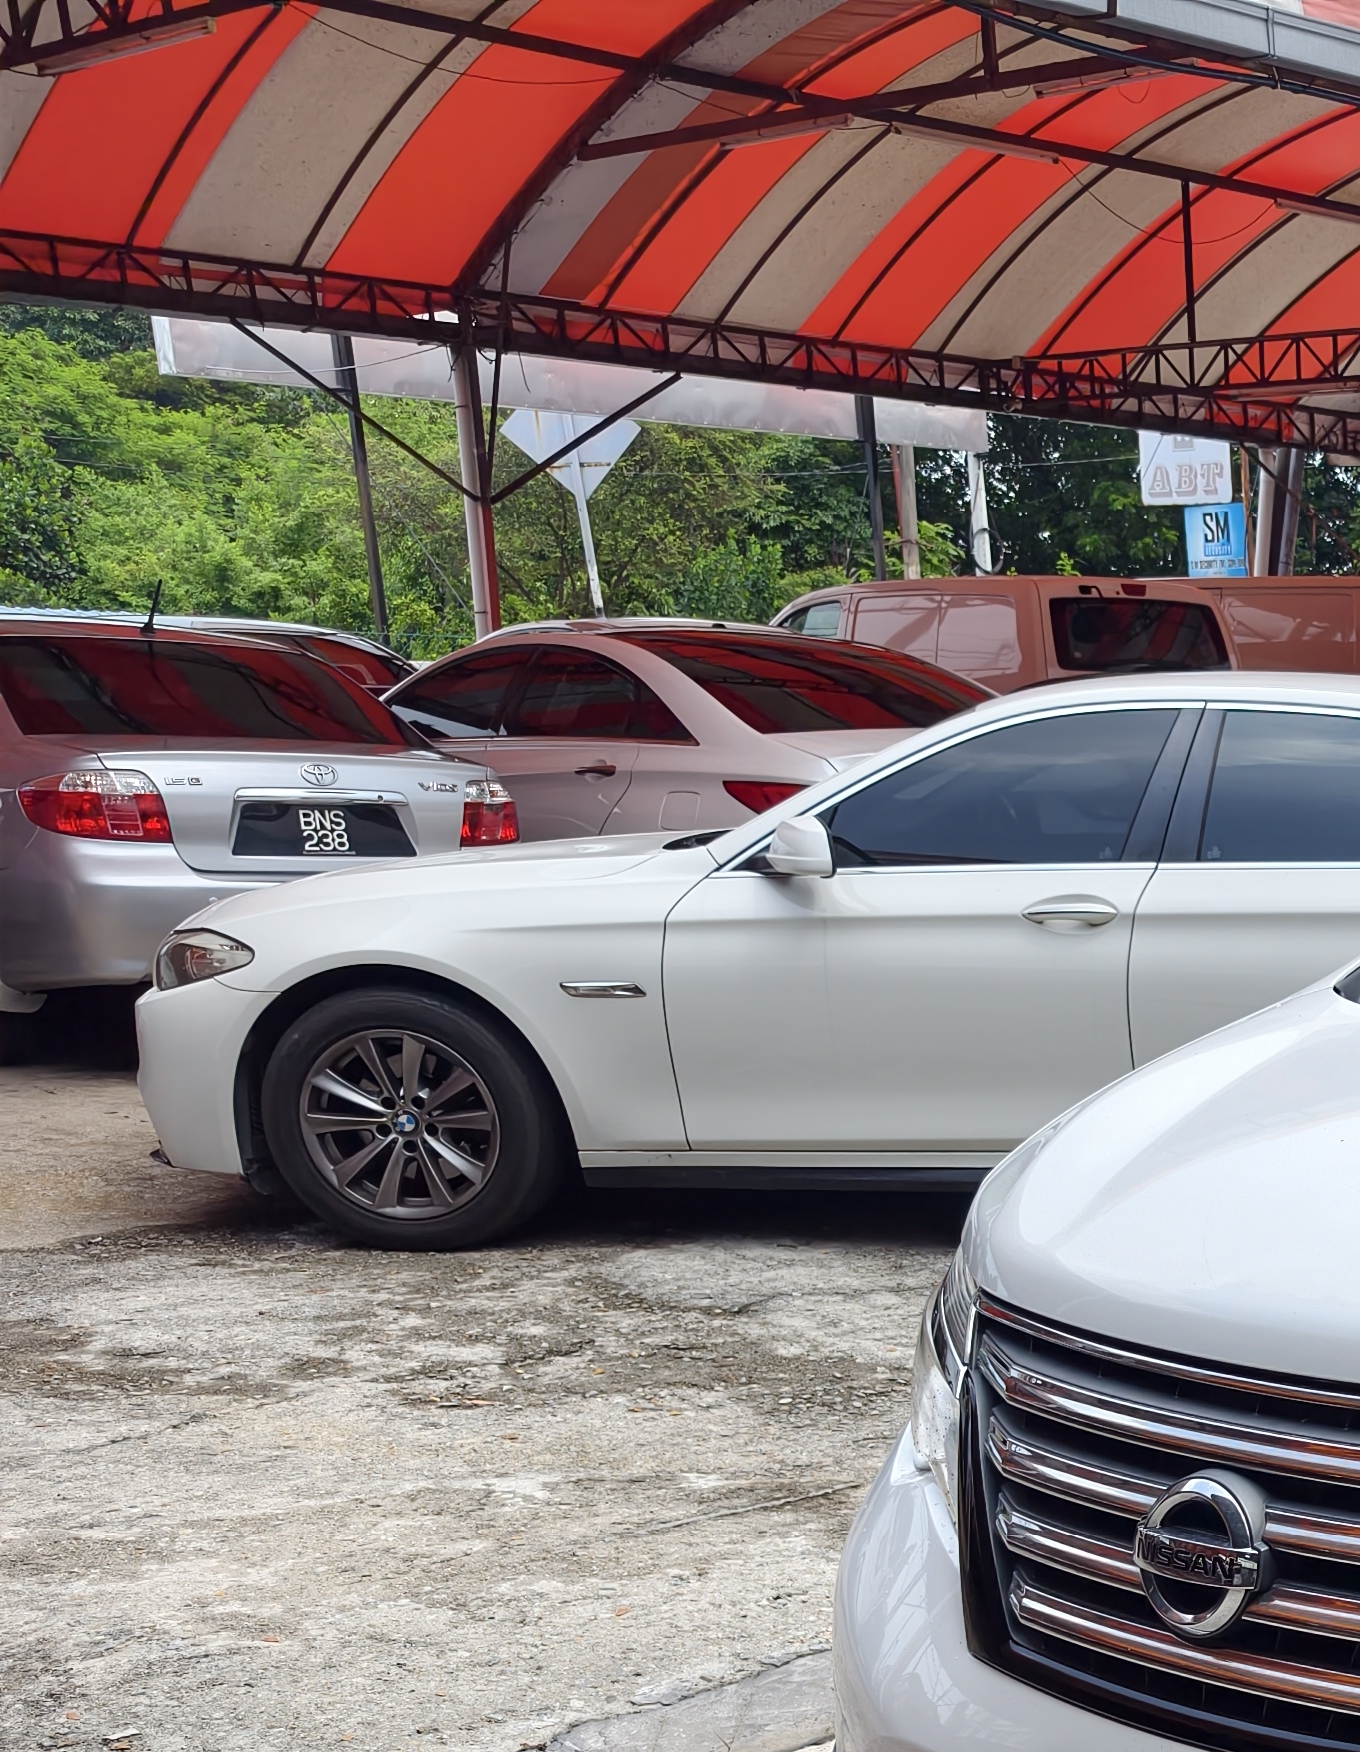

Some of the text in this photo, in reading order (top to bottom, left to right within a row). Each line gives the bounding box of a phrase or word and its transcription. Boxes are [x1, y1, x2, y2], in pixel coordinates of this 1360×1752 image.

[1148, 462, 1224, 498] ABT
[1203, 511, 1231, 543] SM
[299, 810, 346, 830] BNS
[303, 830, 350, 851] 238
[1138, 1535, 1241, 1584] NISSAN
